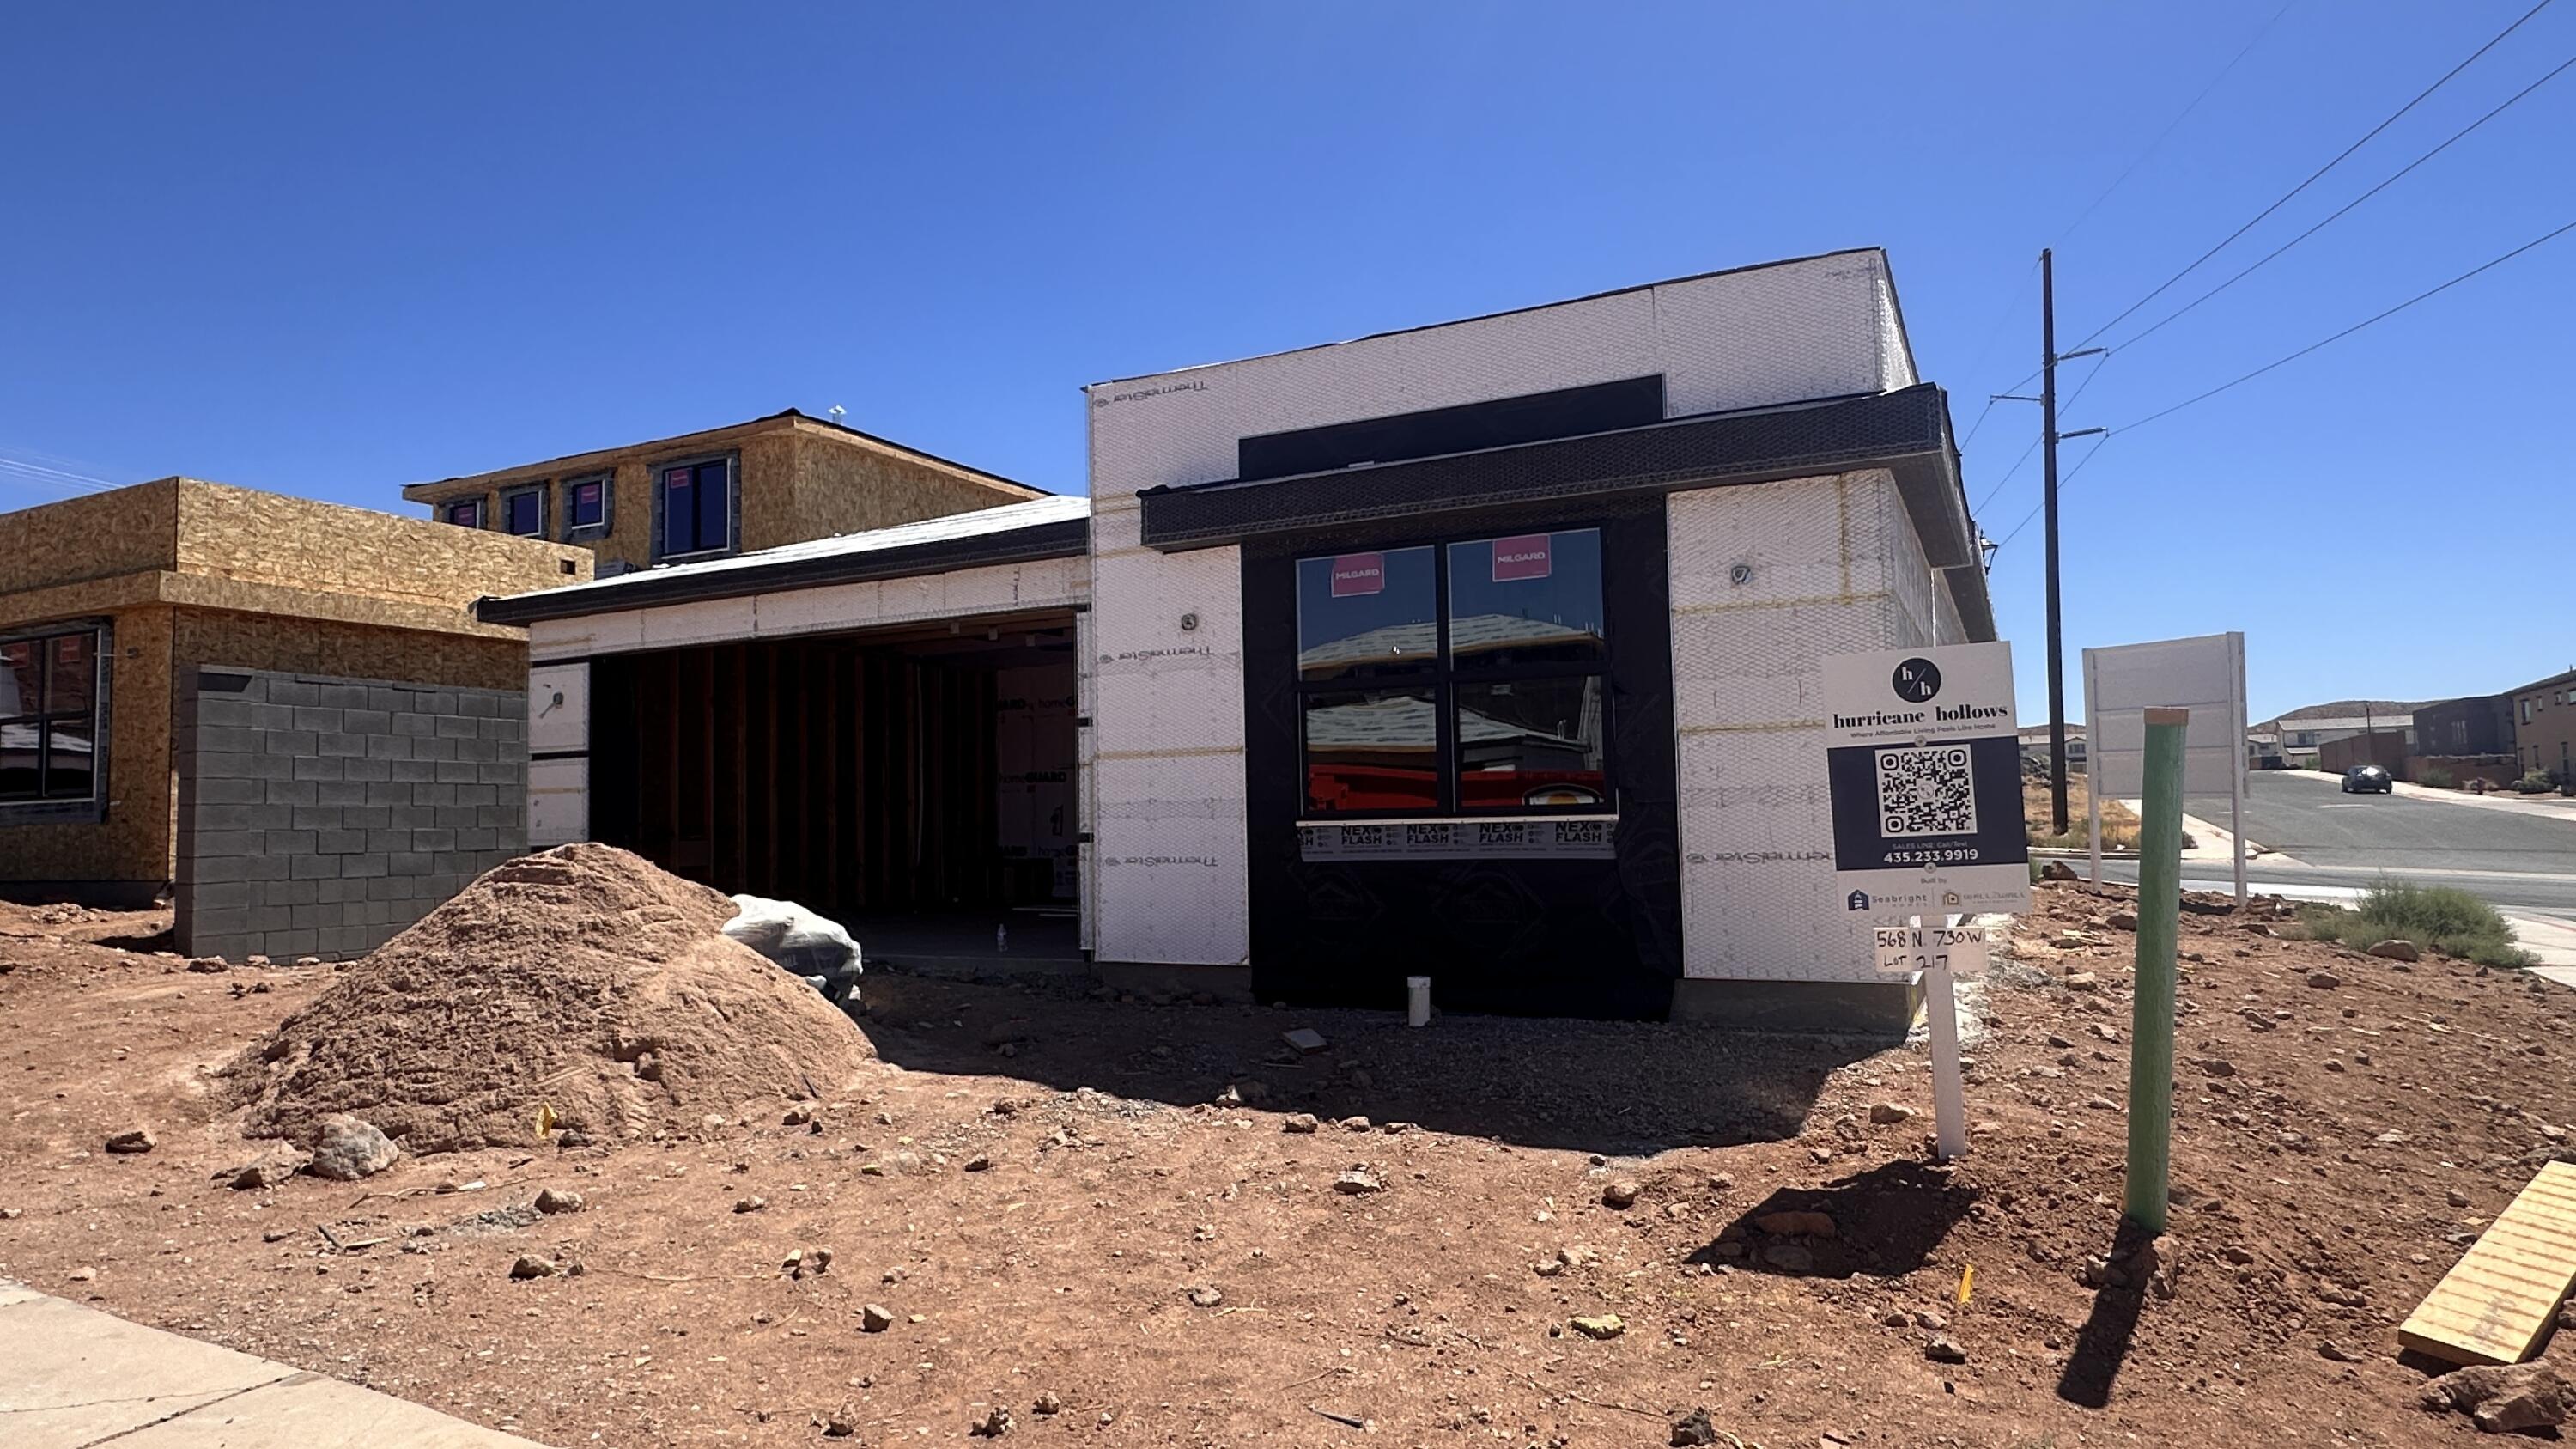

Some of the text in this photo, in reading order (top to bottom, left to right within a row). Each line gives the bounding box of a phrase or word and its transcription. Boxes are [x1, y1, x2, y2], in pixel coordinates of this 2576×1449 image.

[1498, 551, 1546, 564] MILGARD
[1335, 568, 1380, 581] MILGARD
[1833, 703, 2008, 728] hurricane hollows
[1341, 835, 1382, 845] FLASH
[1406, 834, 1449, 845] FLASH
[1479, 832, 1523, 843] FLASH
[1555, 832, 1601, 843] FLASH
[1884, 849, 1978, 863] 435.233.9919
[1872, 894, 1928, 904] Seabright
[1877, 930, 1907, 948] 568
[1884, 954, 1949, 970] LOT 217
